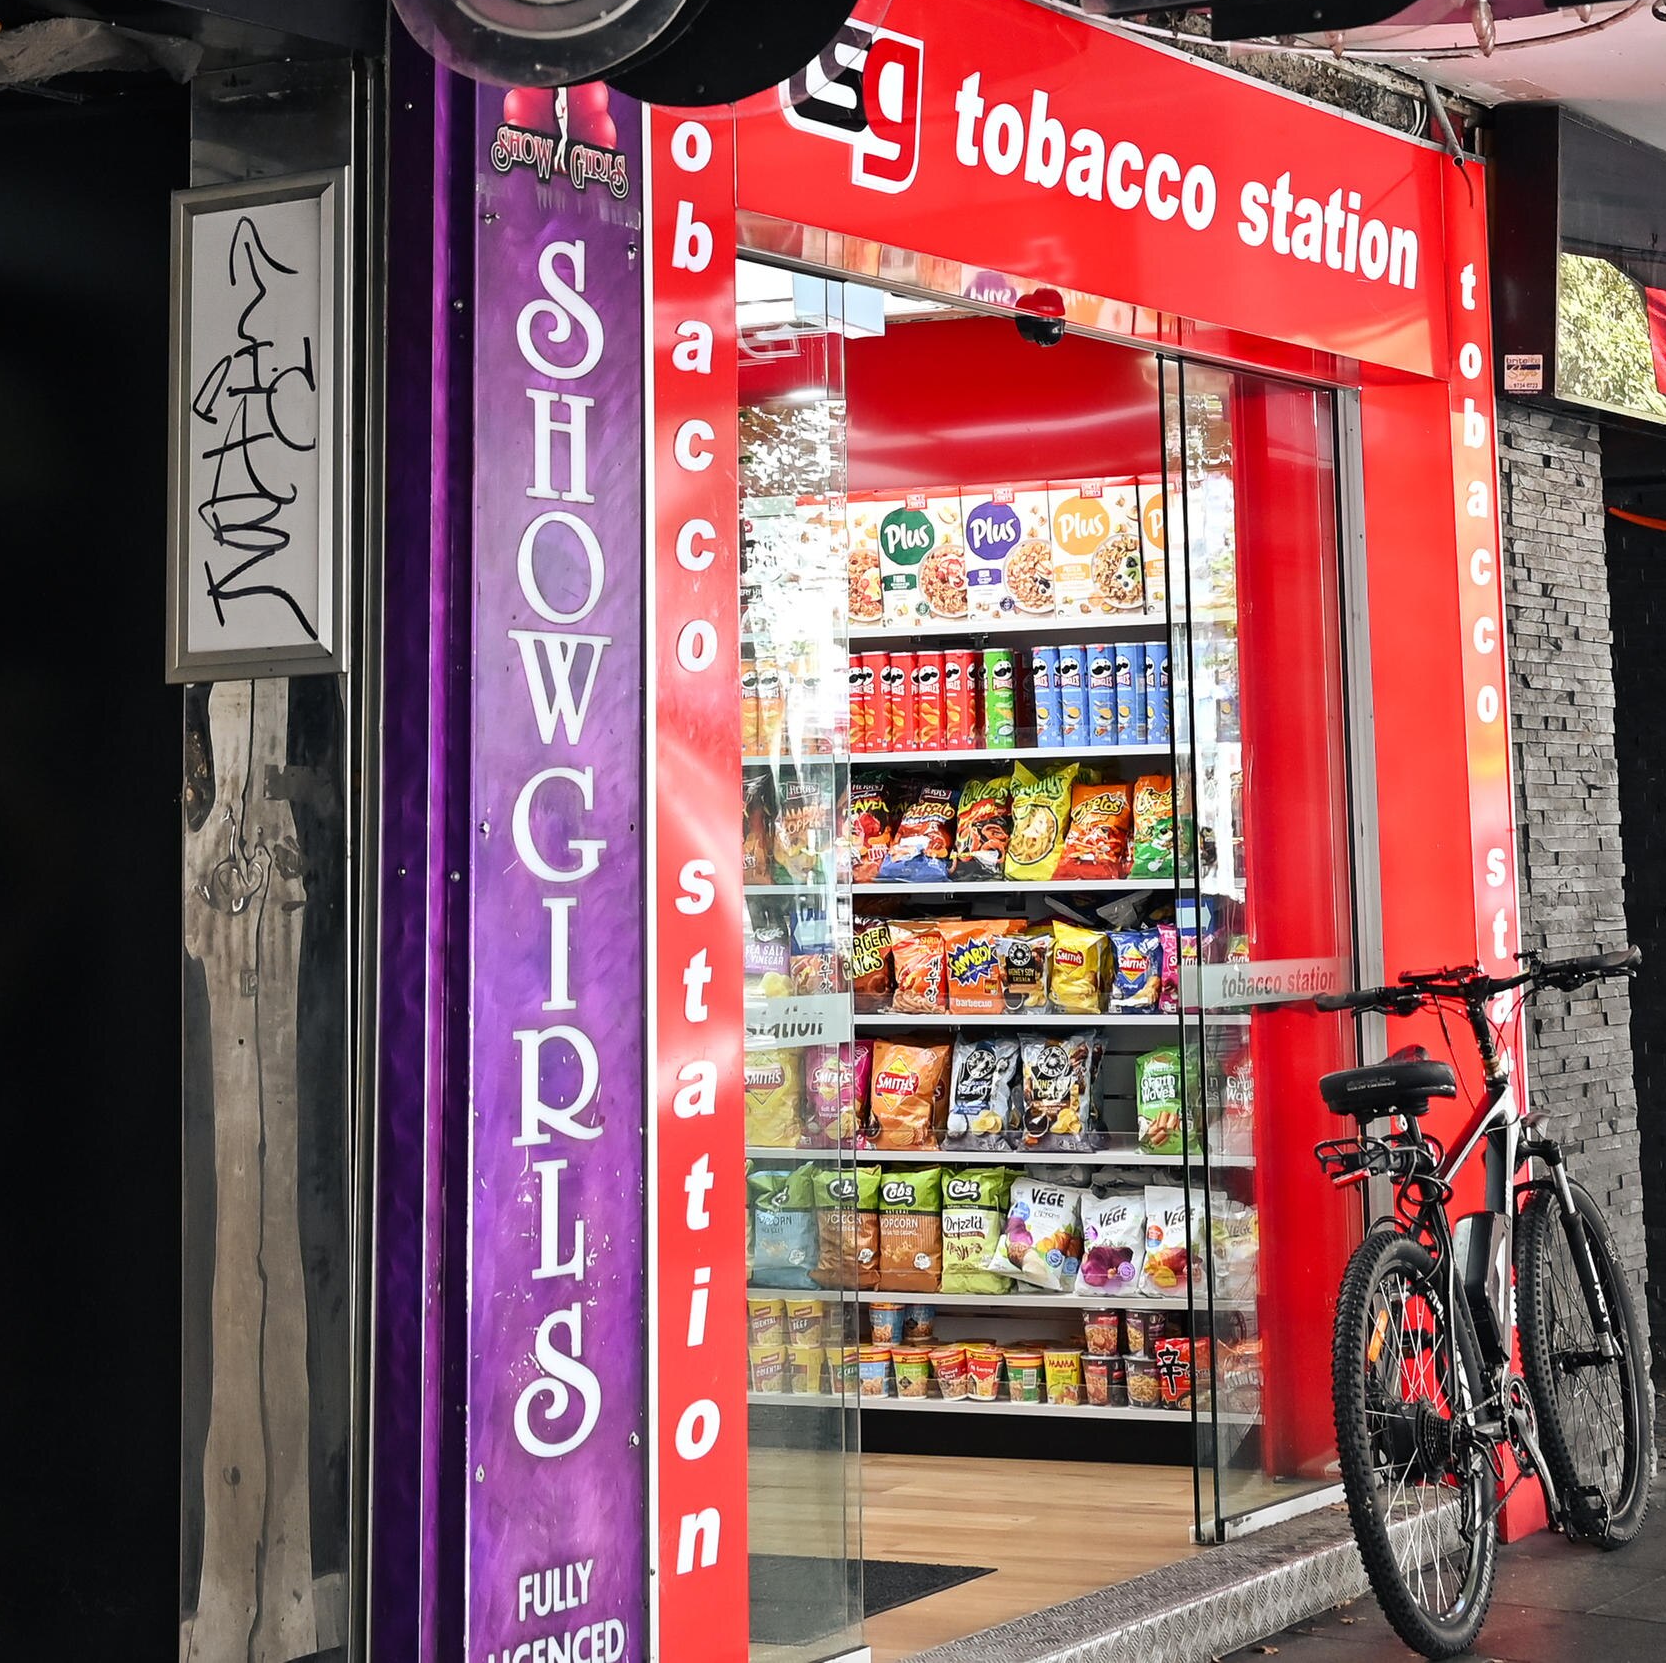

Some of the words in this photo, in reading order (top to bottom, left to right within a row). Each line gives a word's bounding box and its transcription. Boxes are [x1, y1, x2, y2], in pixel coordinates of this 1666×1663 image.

[491, 126, 553, 179] SHOW
[570, 145, 629, 198] GIRLS
[778, 19, 925, 194] sg
[954, 72, 1217, 232] tobacco
[1237, 170, 1419, 291] station
[670, 120, 720, 672] obacco
[1460, 262, 1499, 724] tobacco
[884, 523, 930, 554] Plus
[969, 517, 1017, 549] Plus
[1058, 512, 1105, 543] Plus
[507, 239, 613, 1458] SHOWGIRLS
[852, 927, 892, 956] RGER
[949, 943, 993, 978] SAMBOY
[1221, 971, 1282, 999] tobacco
[876, 1073, 917, 1094] SMITH'S
[1141, 1086, 1176, 1100] Waves
[1032, 1188, 1065, 1208] VEGE
[674, 856, 721, 1574] station
[1099, 1208, 1127, 1228] VEGE
[518, 1558, 594, 1623] FULLY
